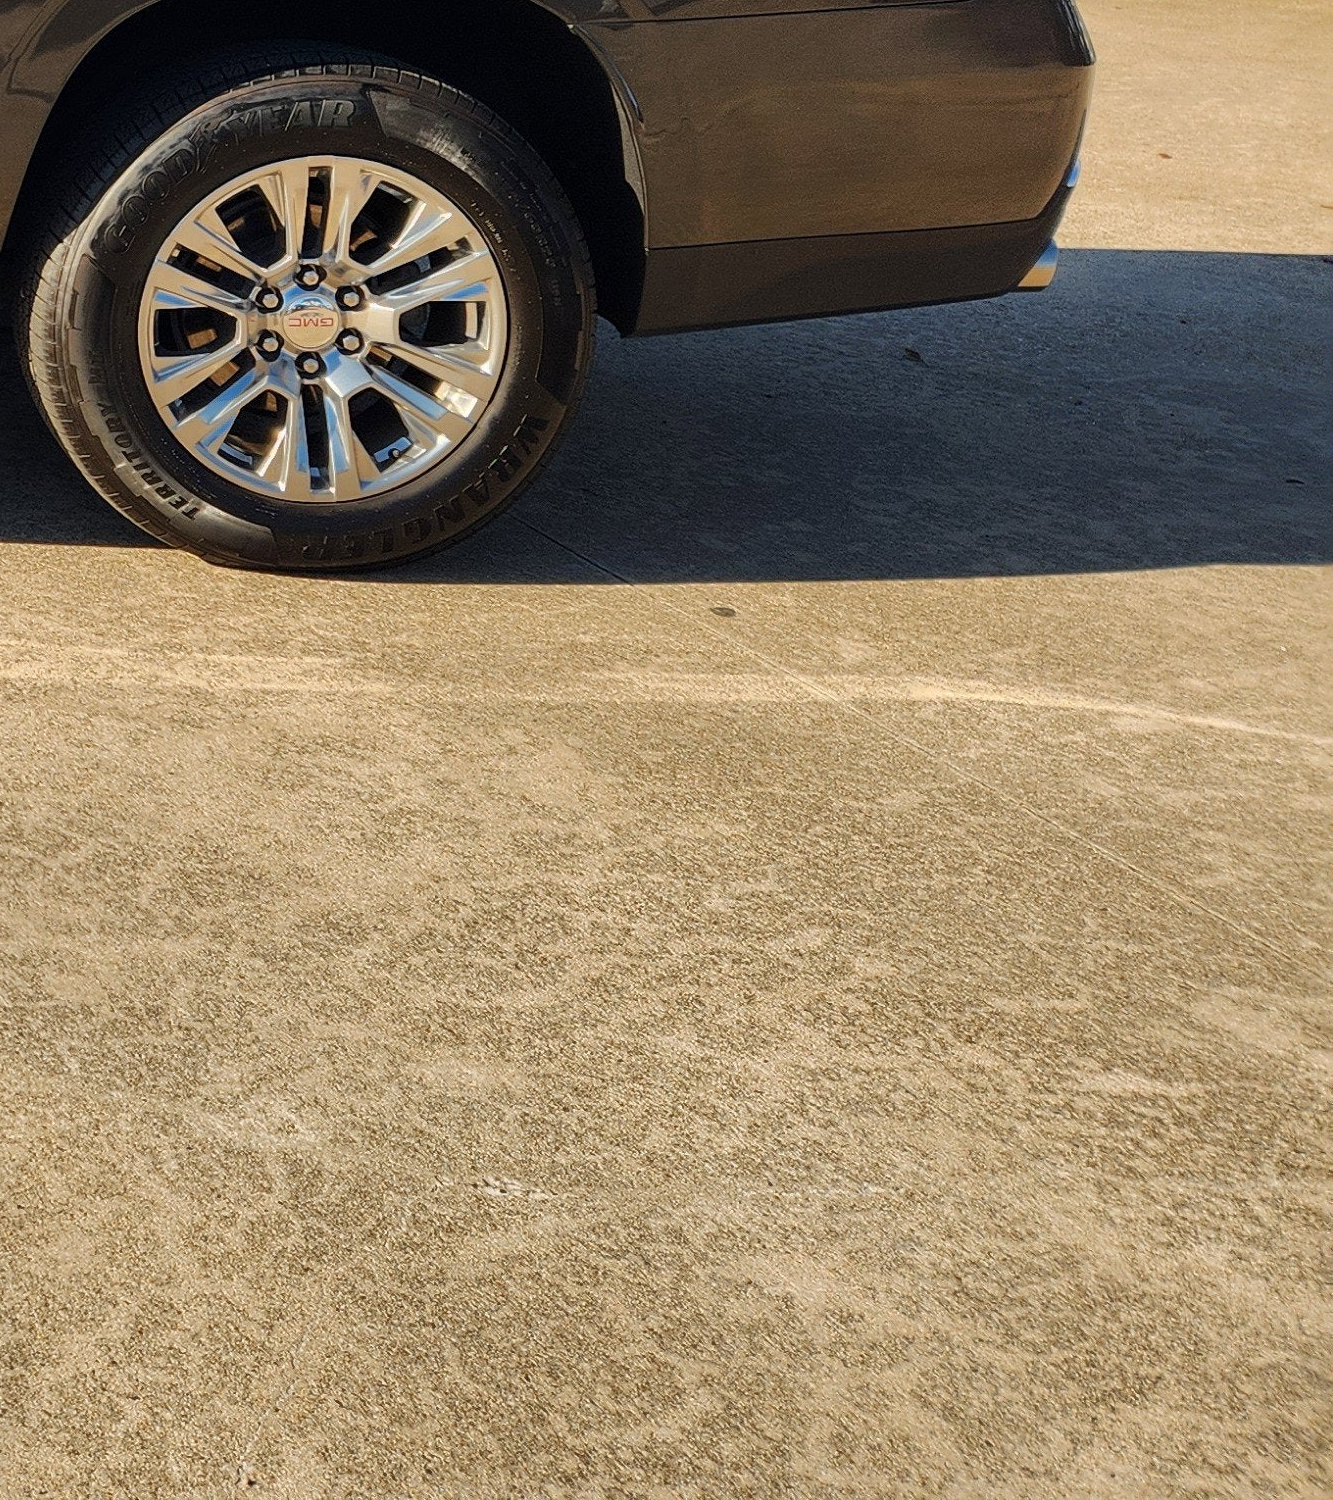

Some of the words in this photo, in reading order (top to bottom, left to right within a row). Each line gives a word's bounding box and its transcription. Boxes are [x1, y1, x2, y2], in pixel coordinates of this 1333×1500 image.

[101, 98, 358, 255] GOODYEAR
[288, 317, 334, 328] GMC
[96, 401, 202, 521] TERRITORY
